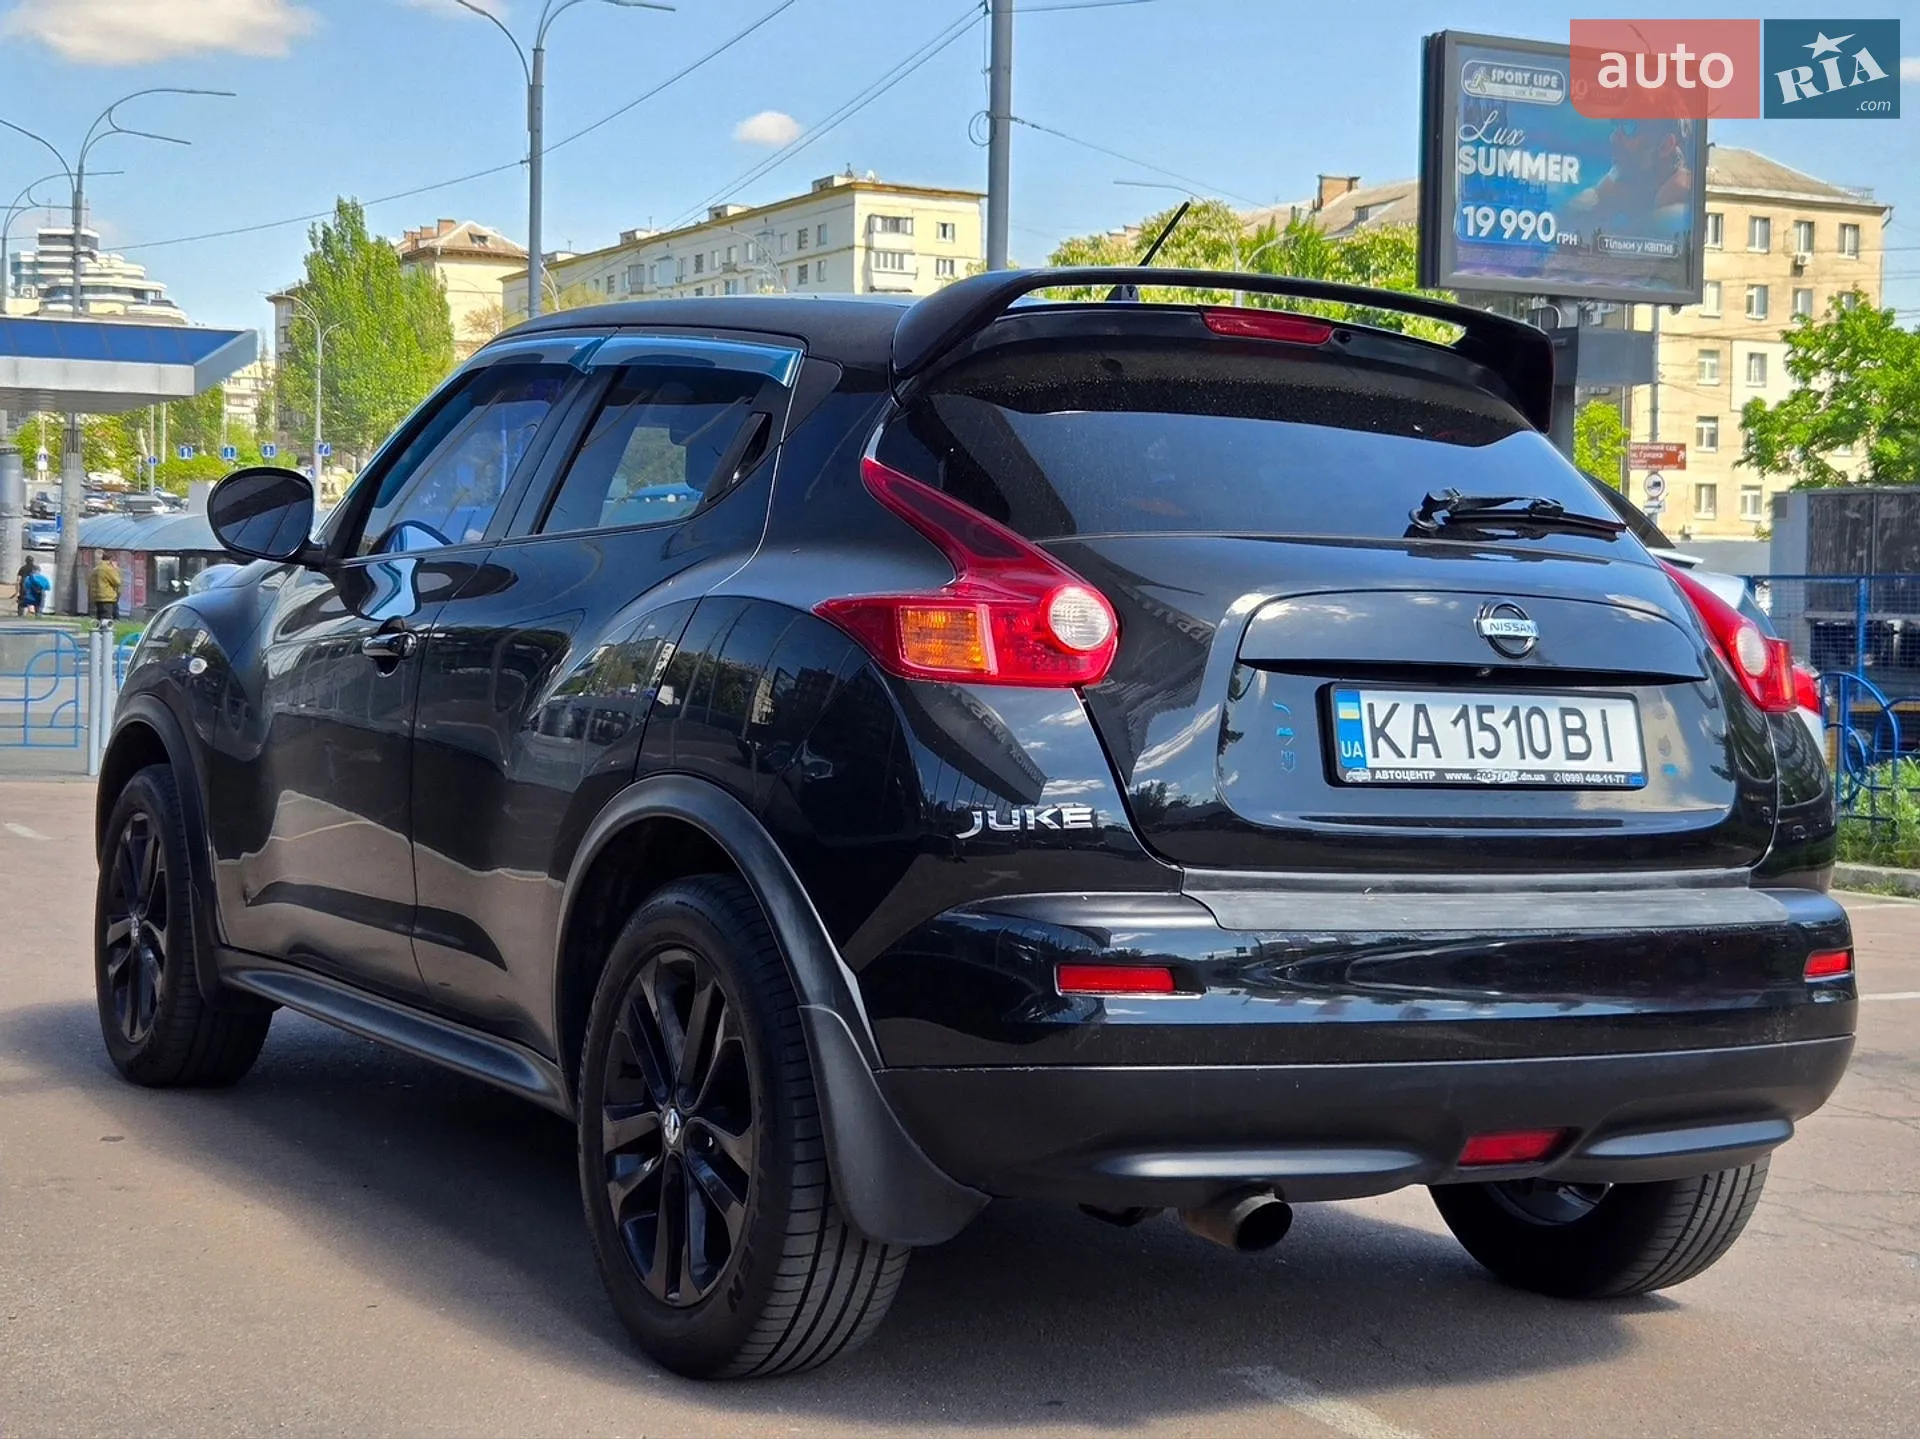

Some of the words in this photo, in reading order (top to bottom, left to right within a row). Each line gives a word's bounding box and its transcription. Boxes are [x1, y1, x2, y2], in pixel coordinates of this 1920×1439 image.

[1491, 69, 1530, 83] SPORT
[1459, 110, 1526, 146] Lux
[1459, 145, 1579, 184] SUMMER
[1462, 206, 1495, 238] 19
[1500, 208, 1557, 242] 990
[1490, 622, 1537, 634] NISSAN
[1367, 702, 1442, 760] KA
[1450, 704, 1551, 761] 1510
[1559, 706, 1613, 763] BI
[1341, 741, 1364, 759] UA
[1375, 770, 1436, 782] АВТОЦЕНТР
[955, 807, 1094, 840] JUKE
